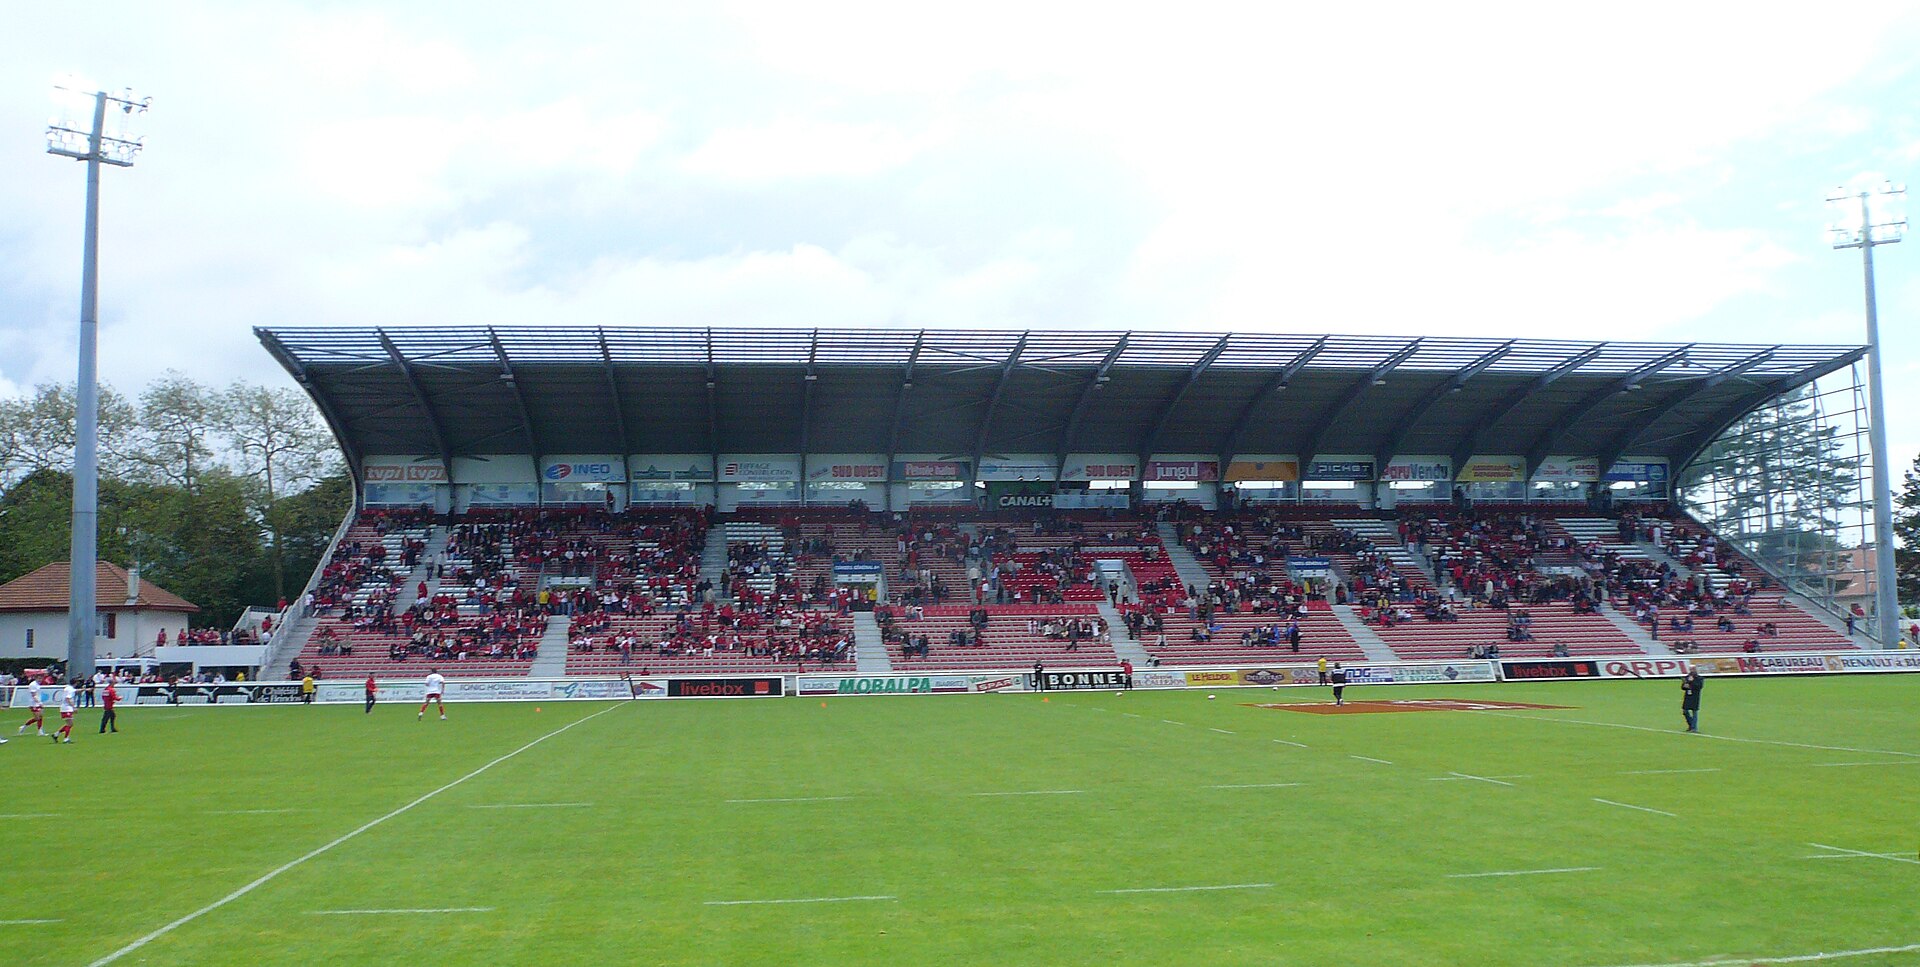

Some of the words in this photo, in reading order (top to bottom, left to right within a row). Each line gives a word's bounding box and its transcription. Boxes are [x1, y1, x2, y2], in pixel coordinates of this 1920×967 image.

[573, 464, 610, 474] INEO
[832, 465, 852, 477] SUD
[854, 465, 885, 477] OUEST
[1086, 465, 1105, 477] SUD
[1107, 464, 1136, 477] OUEST
[1156, 462, 1199, 481] jungul
[1000, 495, 1052, 507] CANAL+
[1605, 660, 1688, 676] ORPI
[1843, 658, 1892, 668] RENAULT
[1512, 663, 1569, 678] livebox
[1049, 673, 1128, 685] BONNET
[1202, 673, 1233, 681] HELDER
[460, 684, 491, 692] TONIC
[493, 683, 513, 691] HOTEL
[680, 682, 745, 696] livebox
[838, 677, 931, 694] MOBALPA
[979, 680, 1012, 691] SPAR
